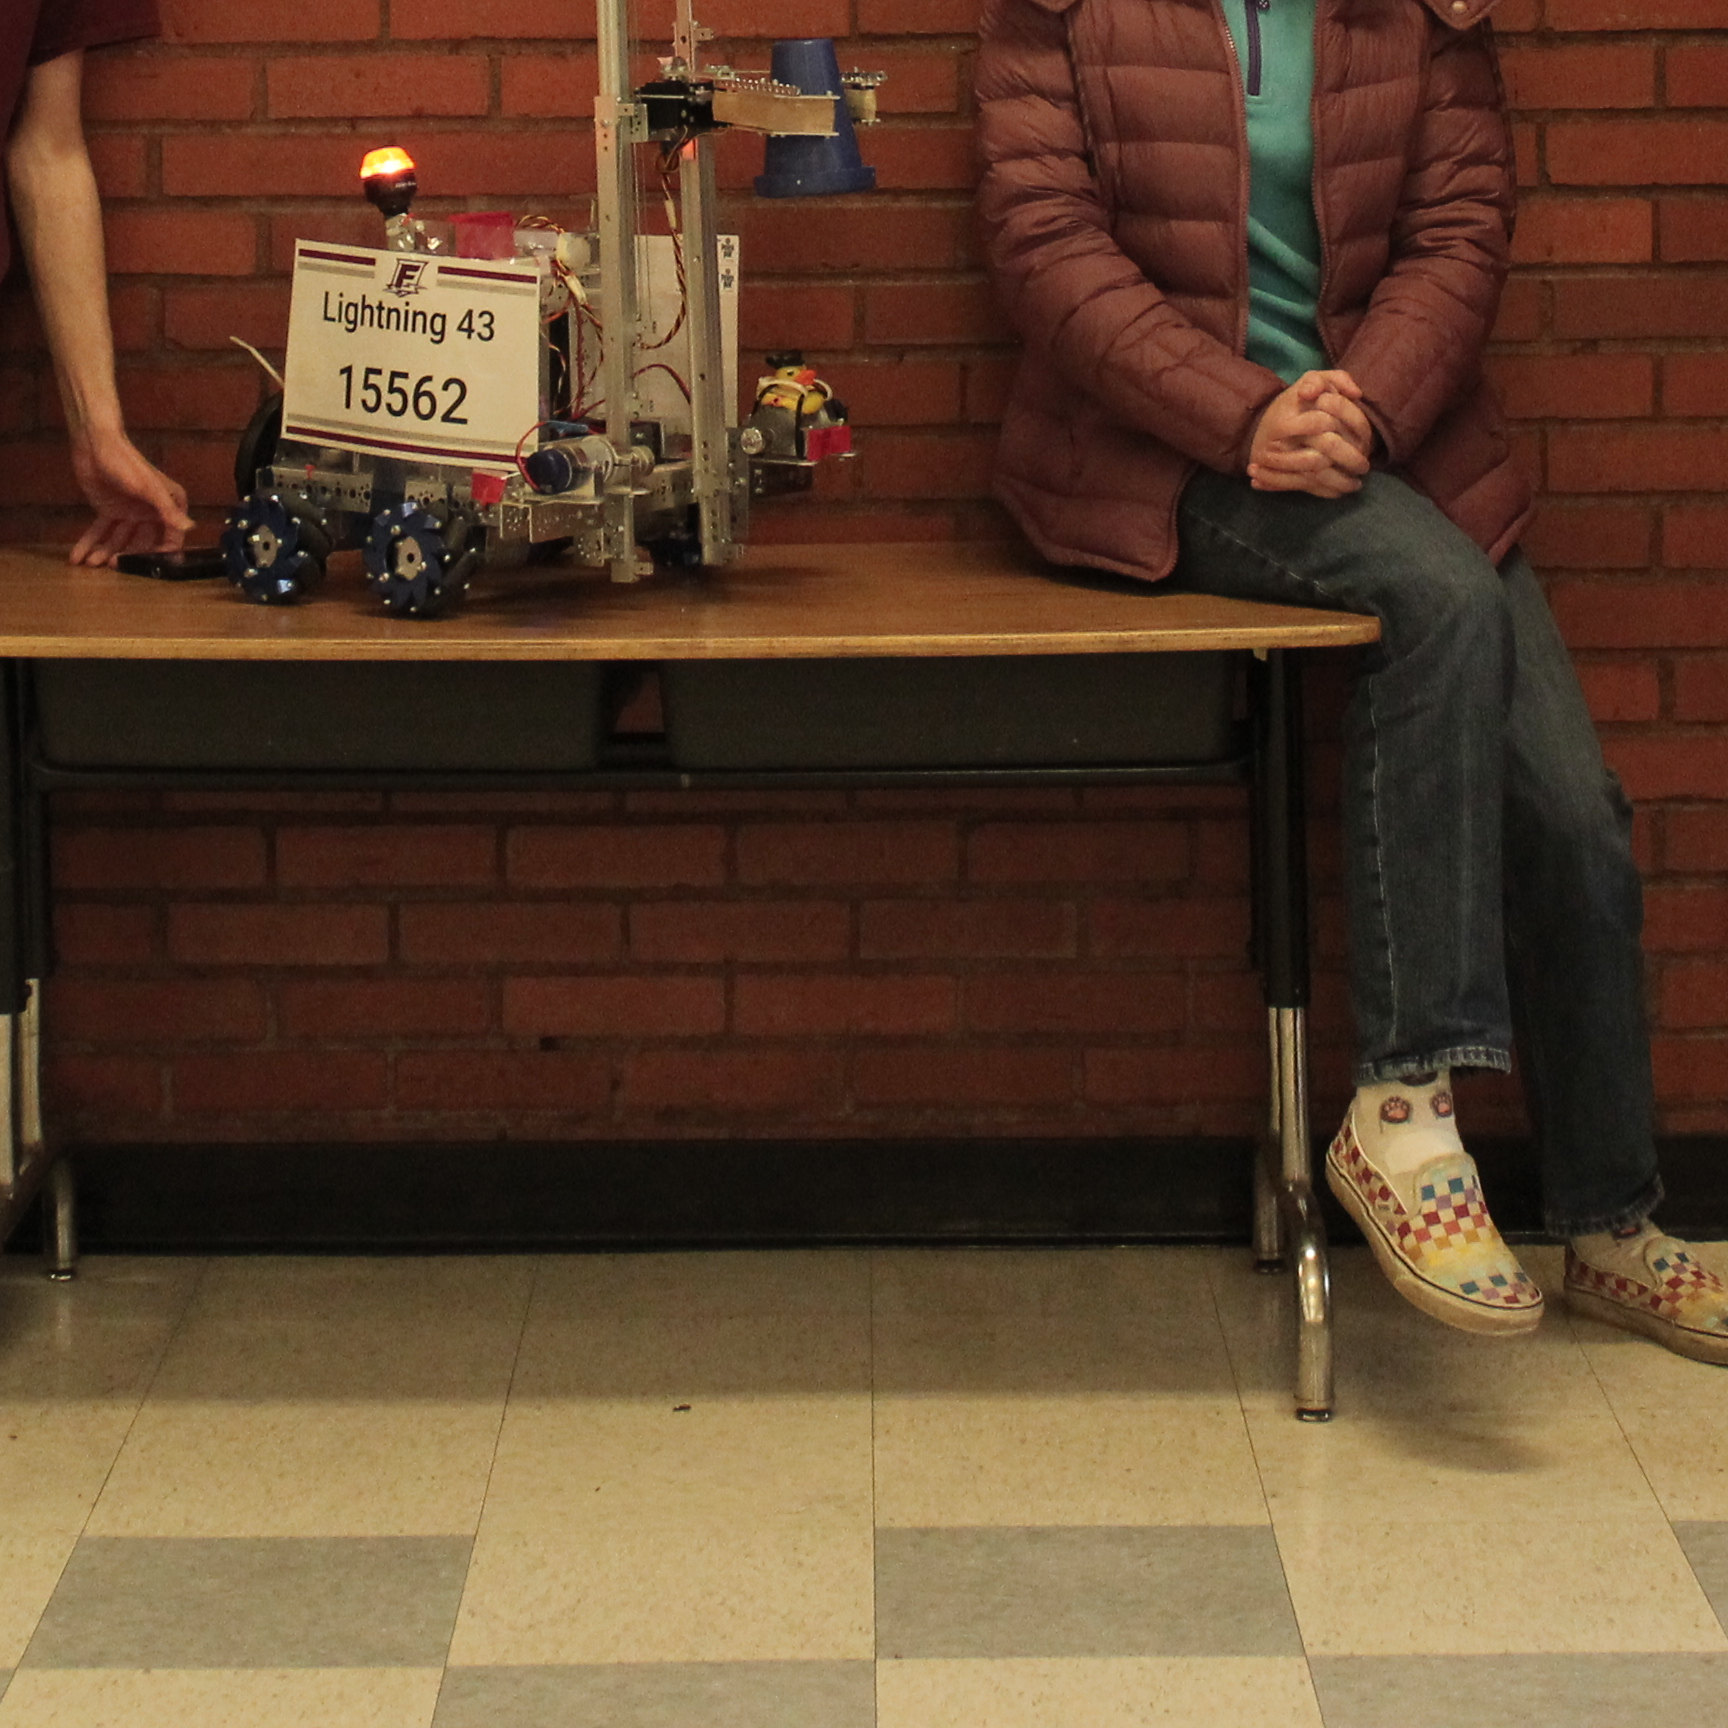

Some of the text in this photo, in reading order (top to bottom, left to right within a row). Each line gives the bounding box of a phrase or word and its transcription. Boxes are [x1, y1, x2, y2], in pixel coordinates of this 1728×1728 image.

[396, 263, 419, 287] F
[323, 291, 495, 344] Lightning 43
[339, 364, 468, 425] 15562
